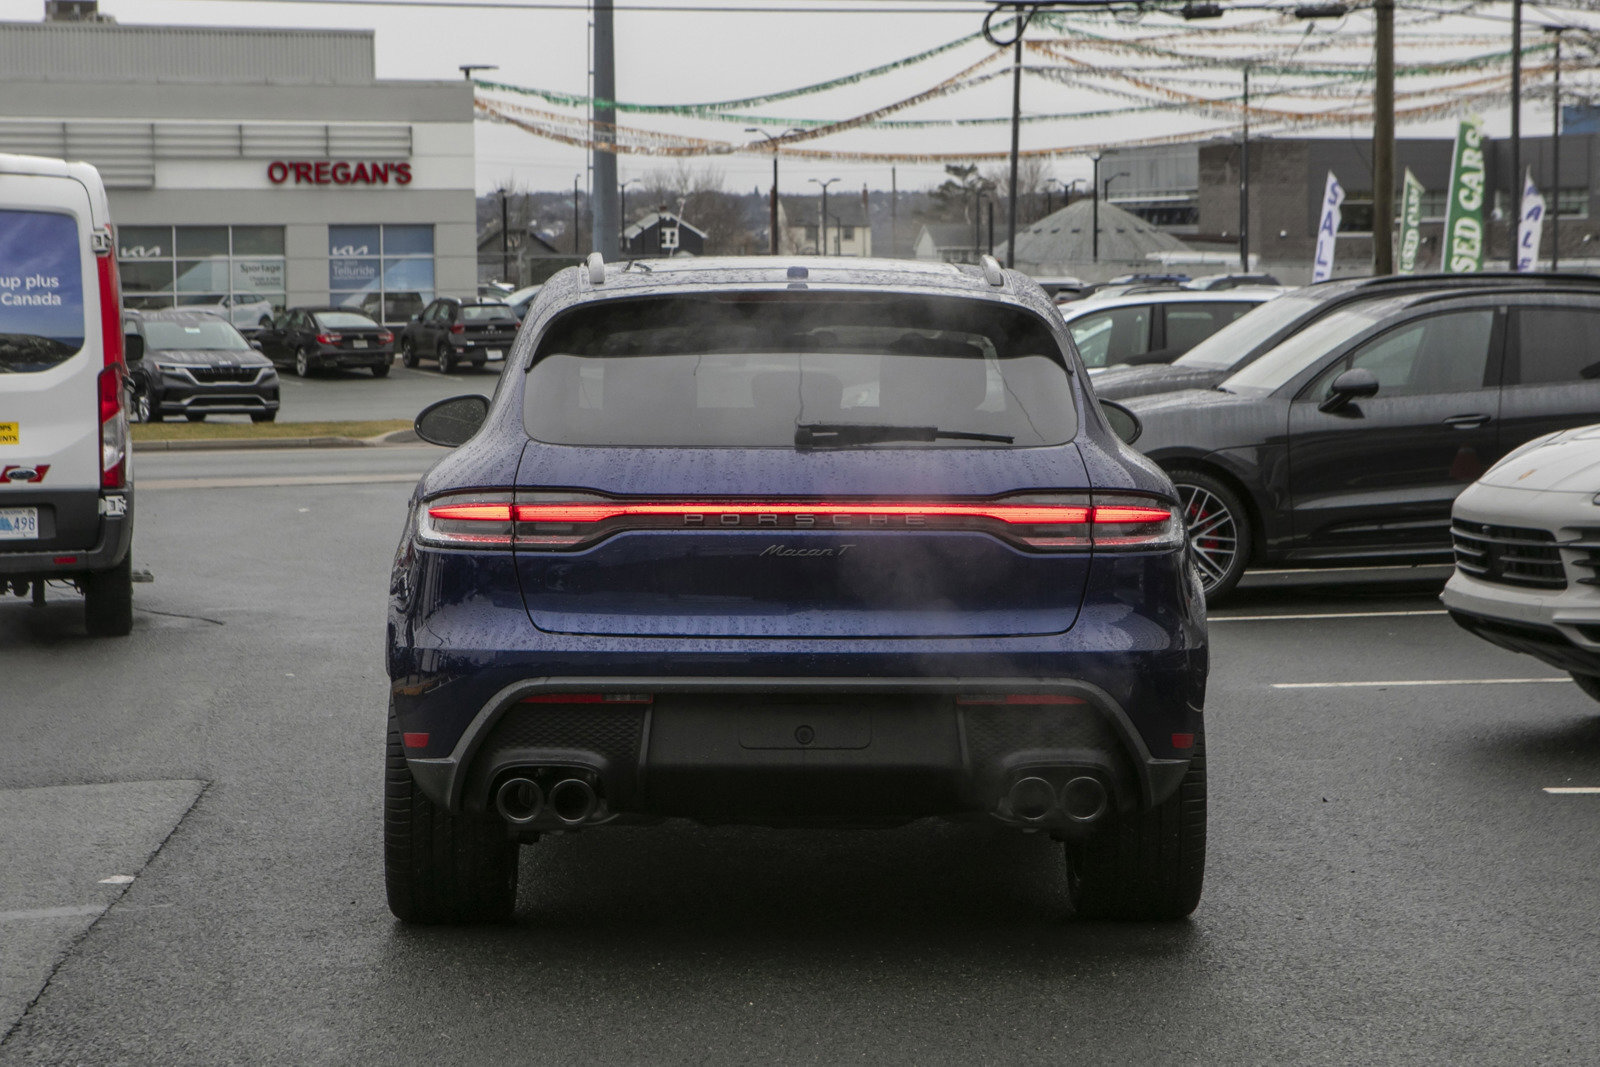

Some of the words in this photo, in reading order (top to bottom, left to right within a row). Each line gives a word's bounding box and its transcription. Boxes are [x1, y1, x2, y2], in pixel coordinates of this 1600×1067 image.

[267, 161, 412, 185] O'REGAN'S
[1458, 127, 1485, 212] CARS
[0, 276, 21, 291] up
[26, 273, 60, 291] plus
[1, 291, 62, 306] Canada
[14, 516, 36, 531] 498
[683, 513, 926, 526] PORSCHE
[759, 543, 834, 558] Macan
[839, 543, 857, 557] T
